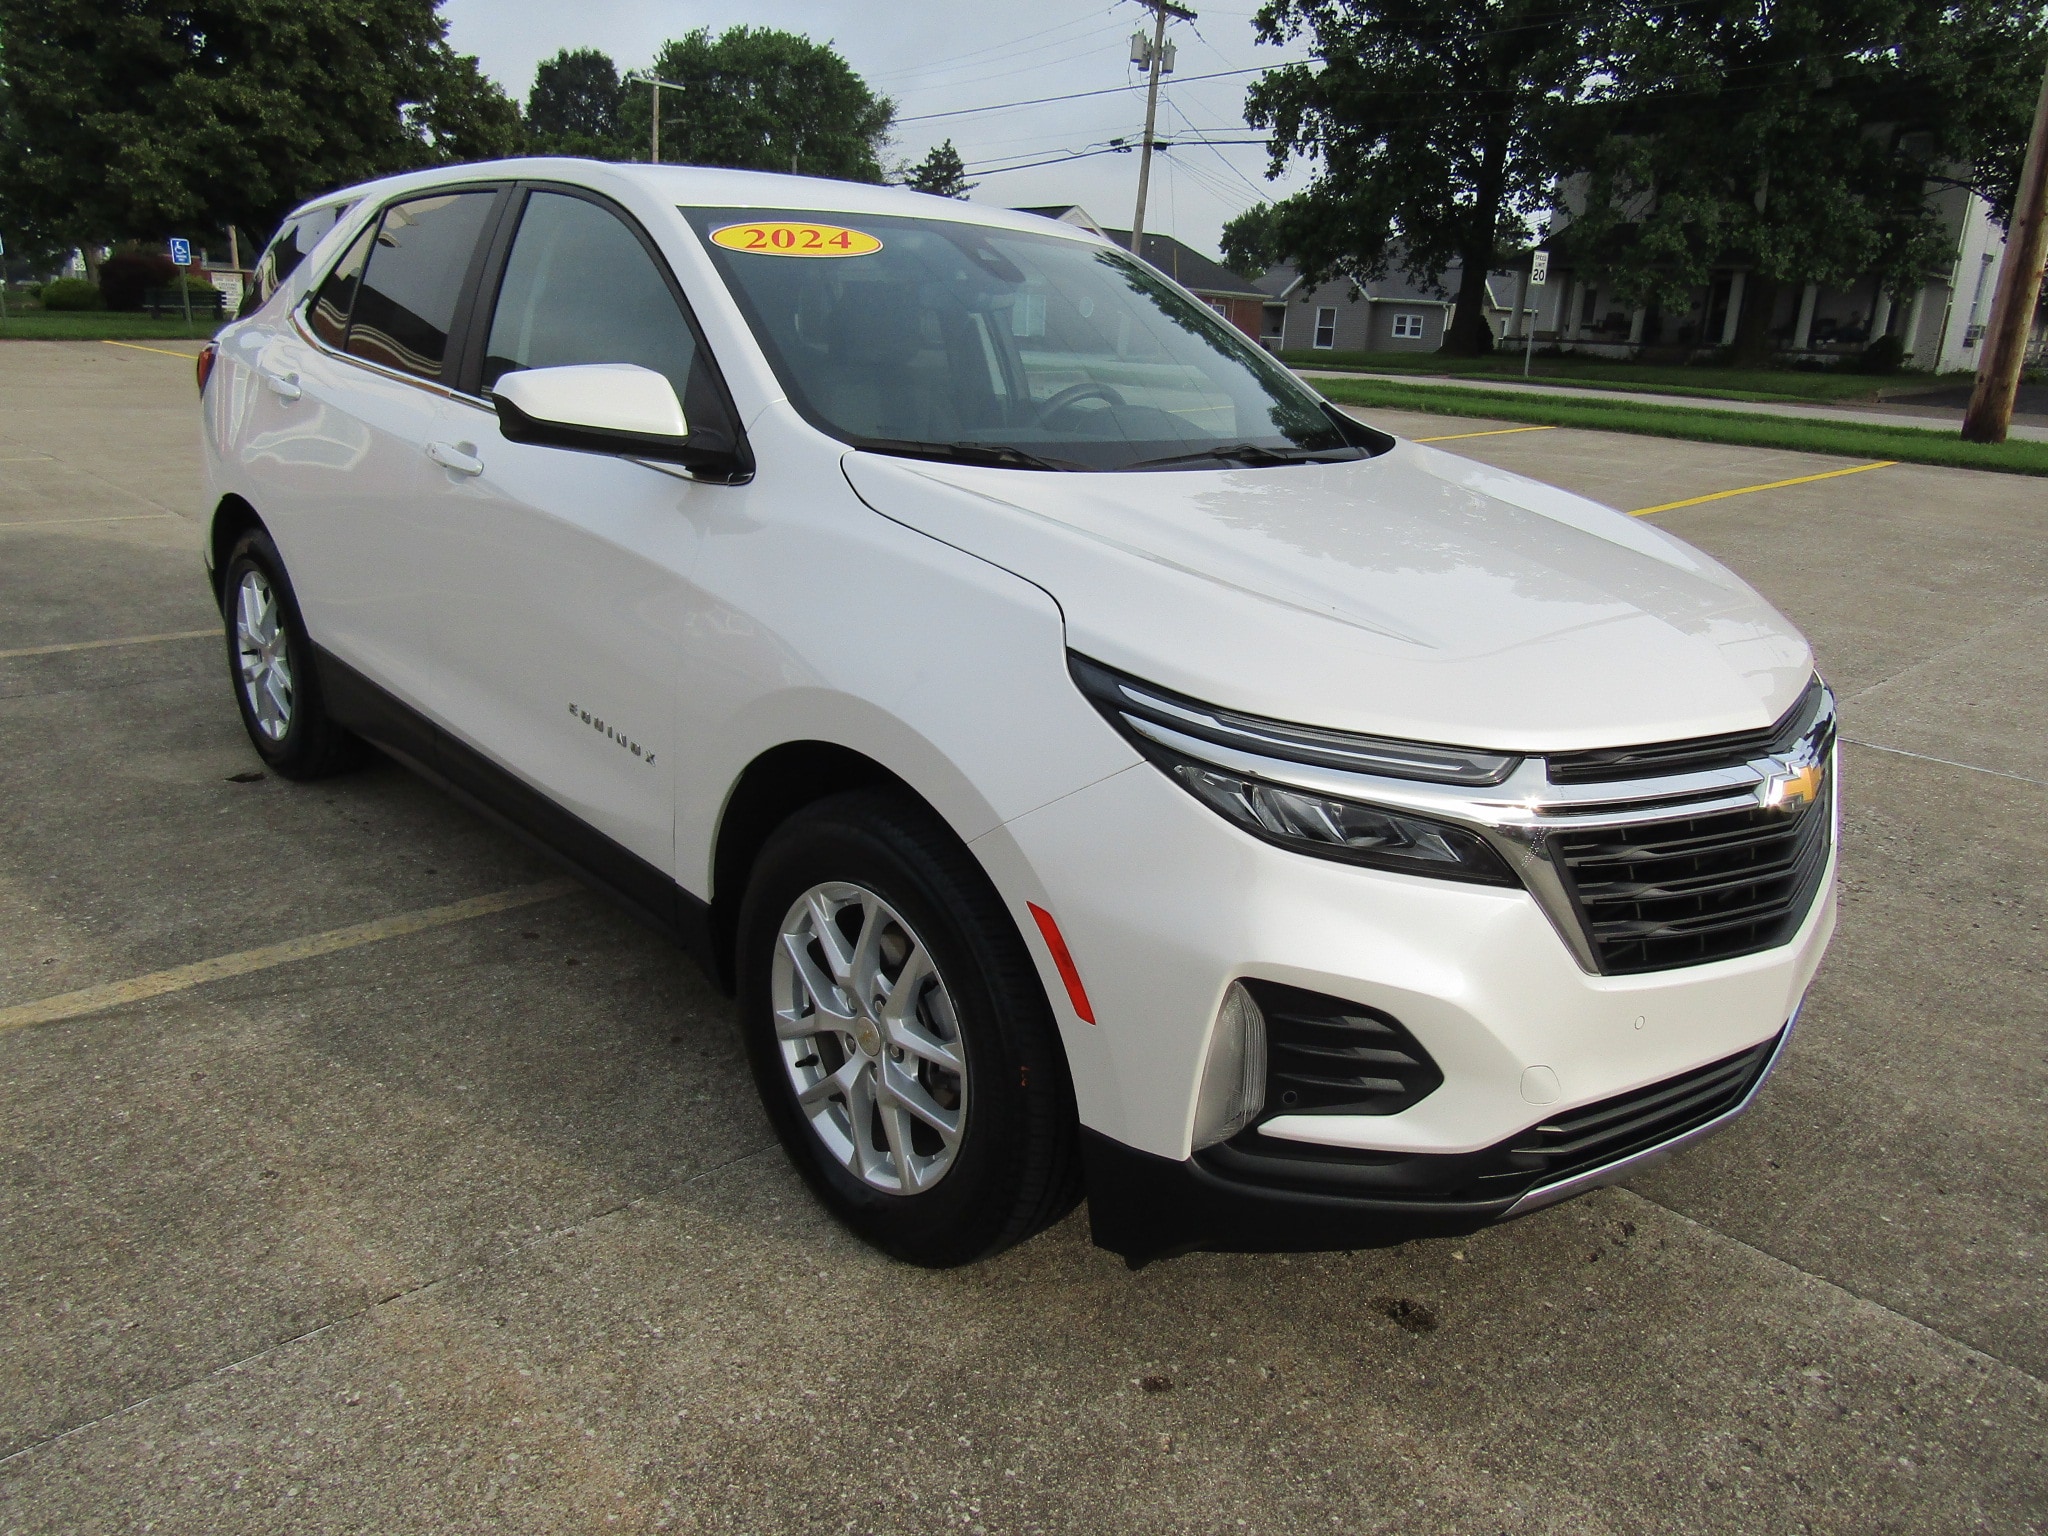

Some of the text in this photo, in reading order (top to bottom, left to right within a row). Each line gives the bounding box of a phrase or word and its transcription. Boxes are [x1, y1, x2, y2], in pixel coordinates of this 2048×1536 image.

[744, 229, 852, 249] 2024
[1532, 269, 1544, 281] 20
[568, 702, 656, 767] EQUINOX
